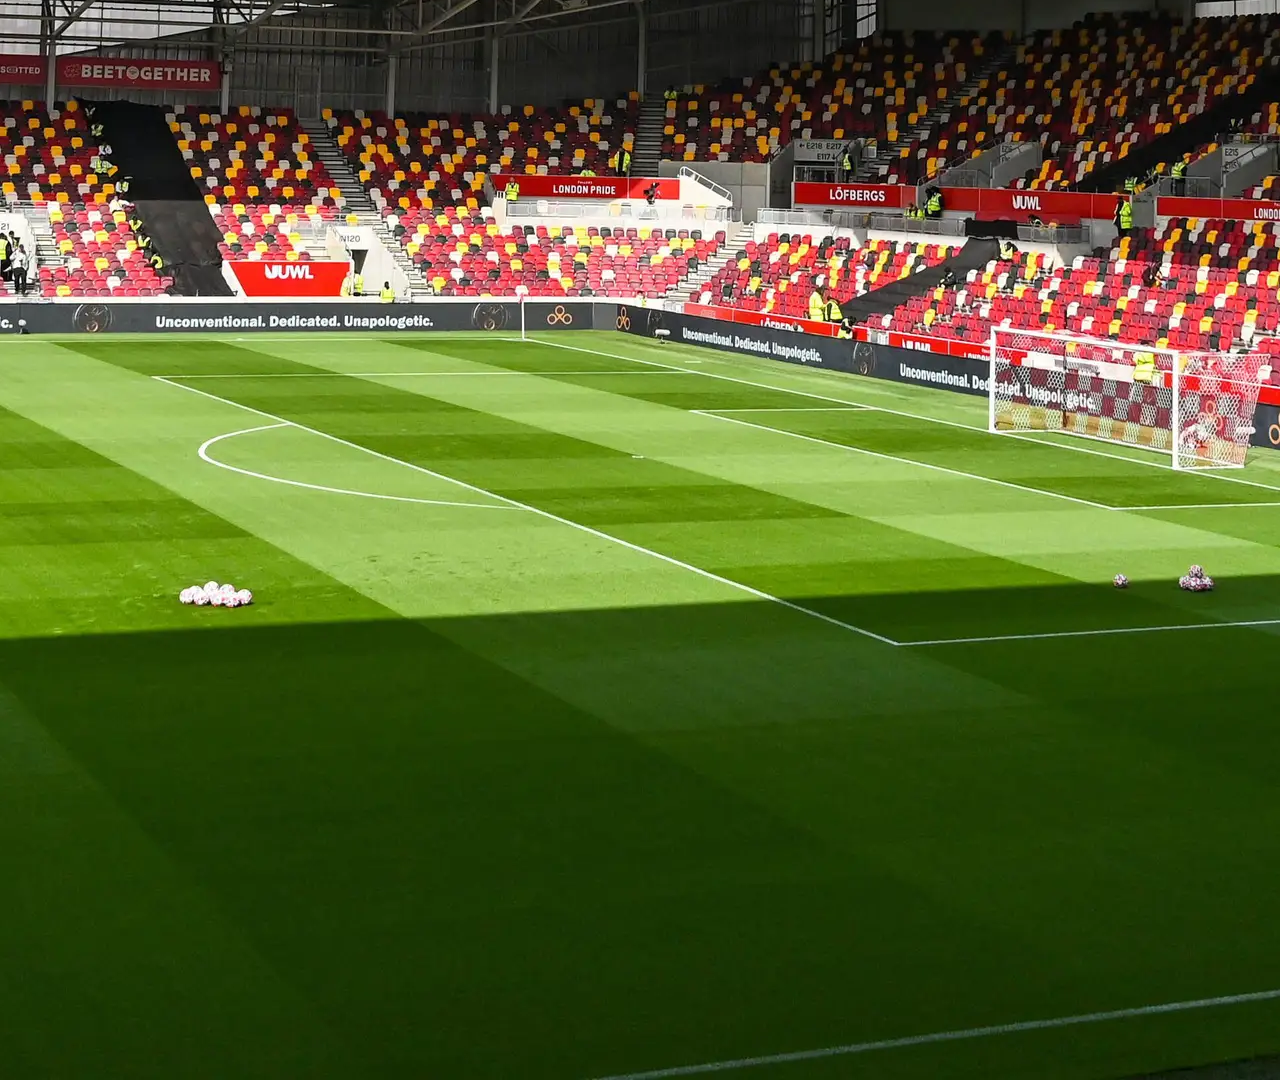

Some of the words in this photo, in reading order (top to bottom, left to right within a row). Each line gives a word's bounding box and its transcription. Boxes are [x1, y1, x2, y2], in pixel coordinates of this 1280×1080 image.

[1224, 148, 1239, 157] E215
[552, 184, 589, 194] LONDON
[590, 185, 616, 195] PRIDE
[829, 186, 885, 202] LÖFBERGS
[155, 315, 266, 328] Unconventional.
[269, 315, 341, 328] Dedicated.
[344, 315, 434, 329] Unapologetic.
[682, 326, 733, 347] Unconventional.
[734, 335, 771, 353] Dedicated.
[772, 342, 822, 363] Unapologetic.
[899, 363, 971, 389] Unconventional.
[972, 375, 1023, 397] Dedcated.
